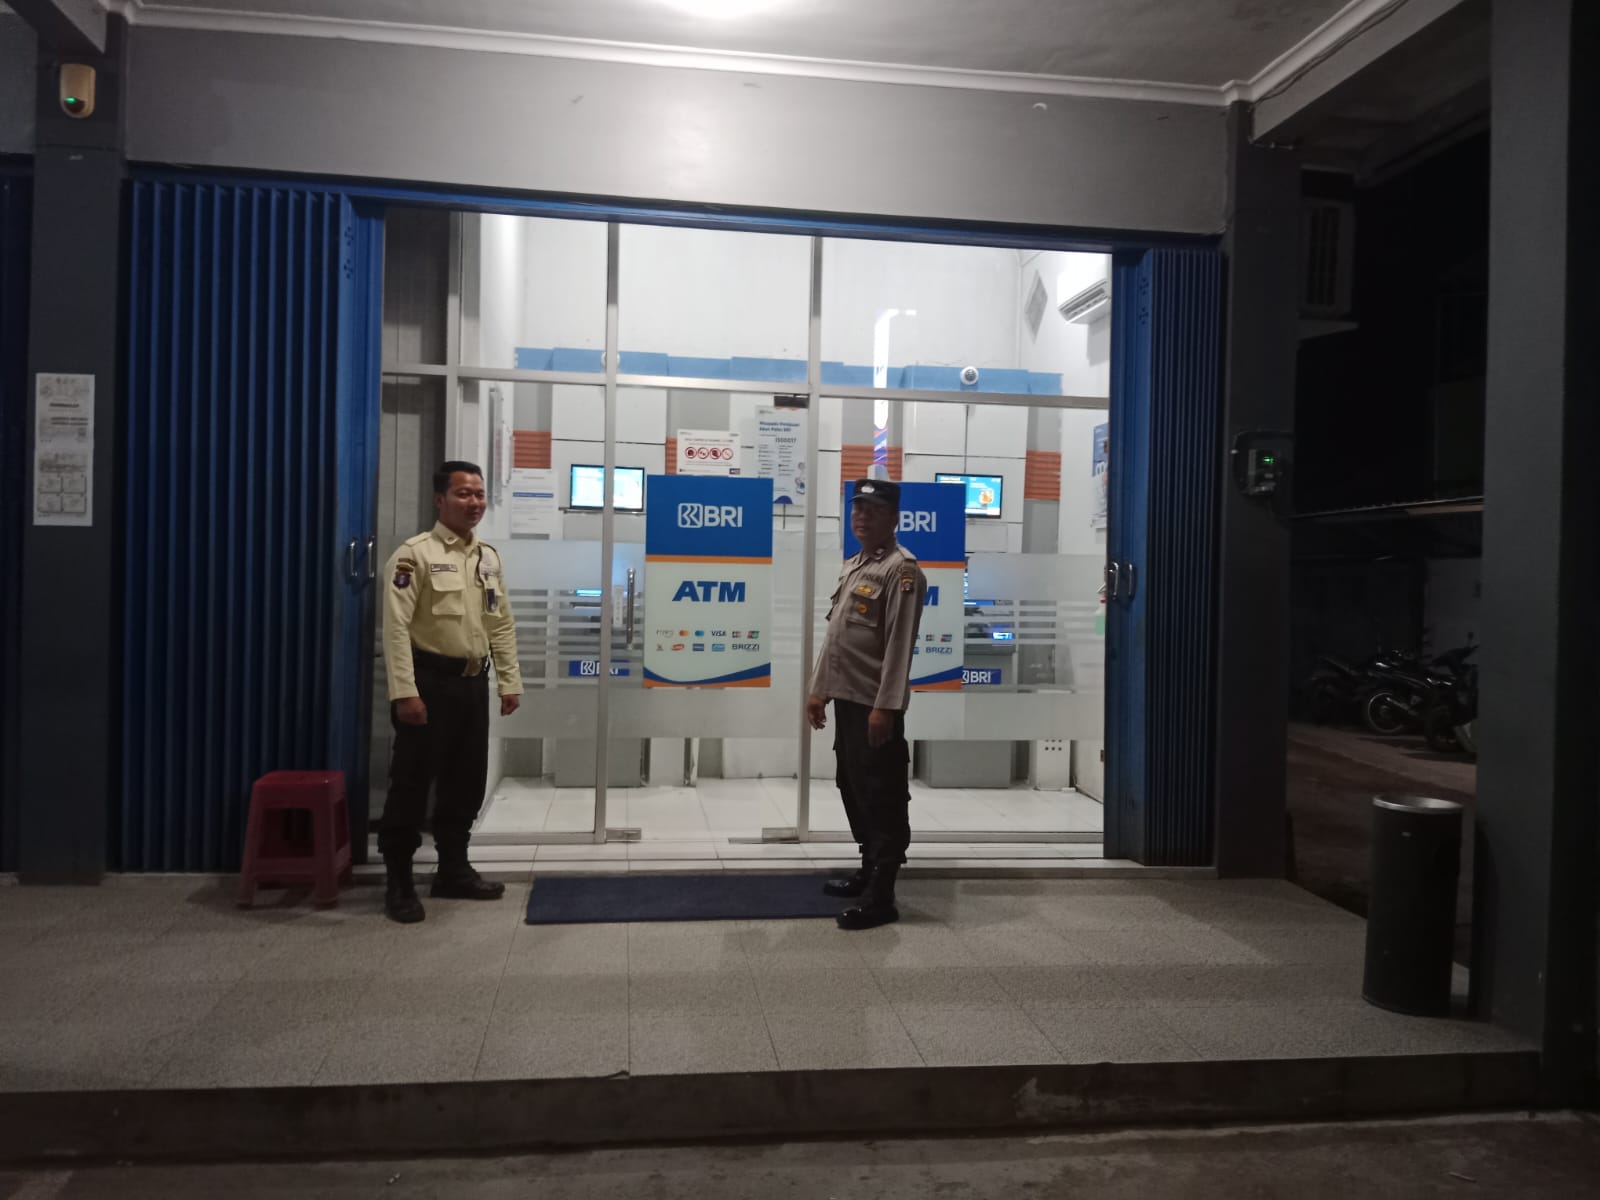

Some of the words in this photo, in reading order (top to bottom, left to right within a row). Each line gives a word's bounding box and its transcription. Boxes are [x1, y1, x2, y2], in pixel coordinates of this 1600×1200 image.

[704, 505, 743, 528] BRI
[900, 512, 936, 533] BRI
[672, 580, 746, 603] ATM
[711, 629, 727, 638] VISA
[732, 643, 760, 651] BRIZZI
[925, 646, 953, 655] BRIZZI
[970, 671, 992, 683] BRI
